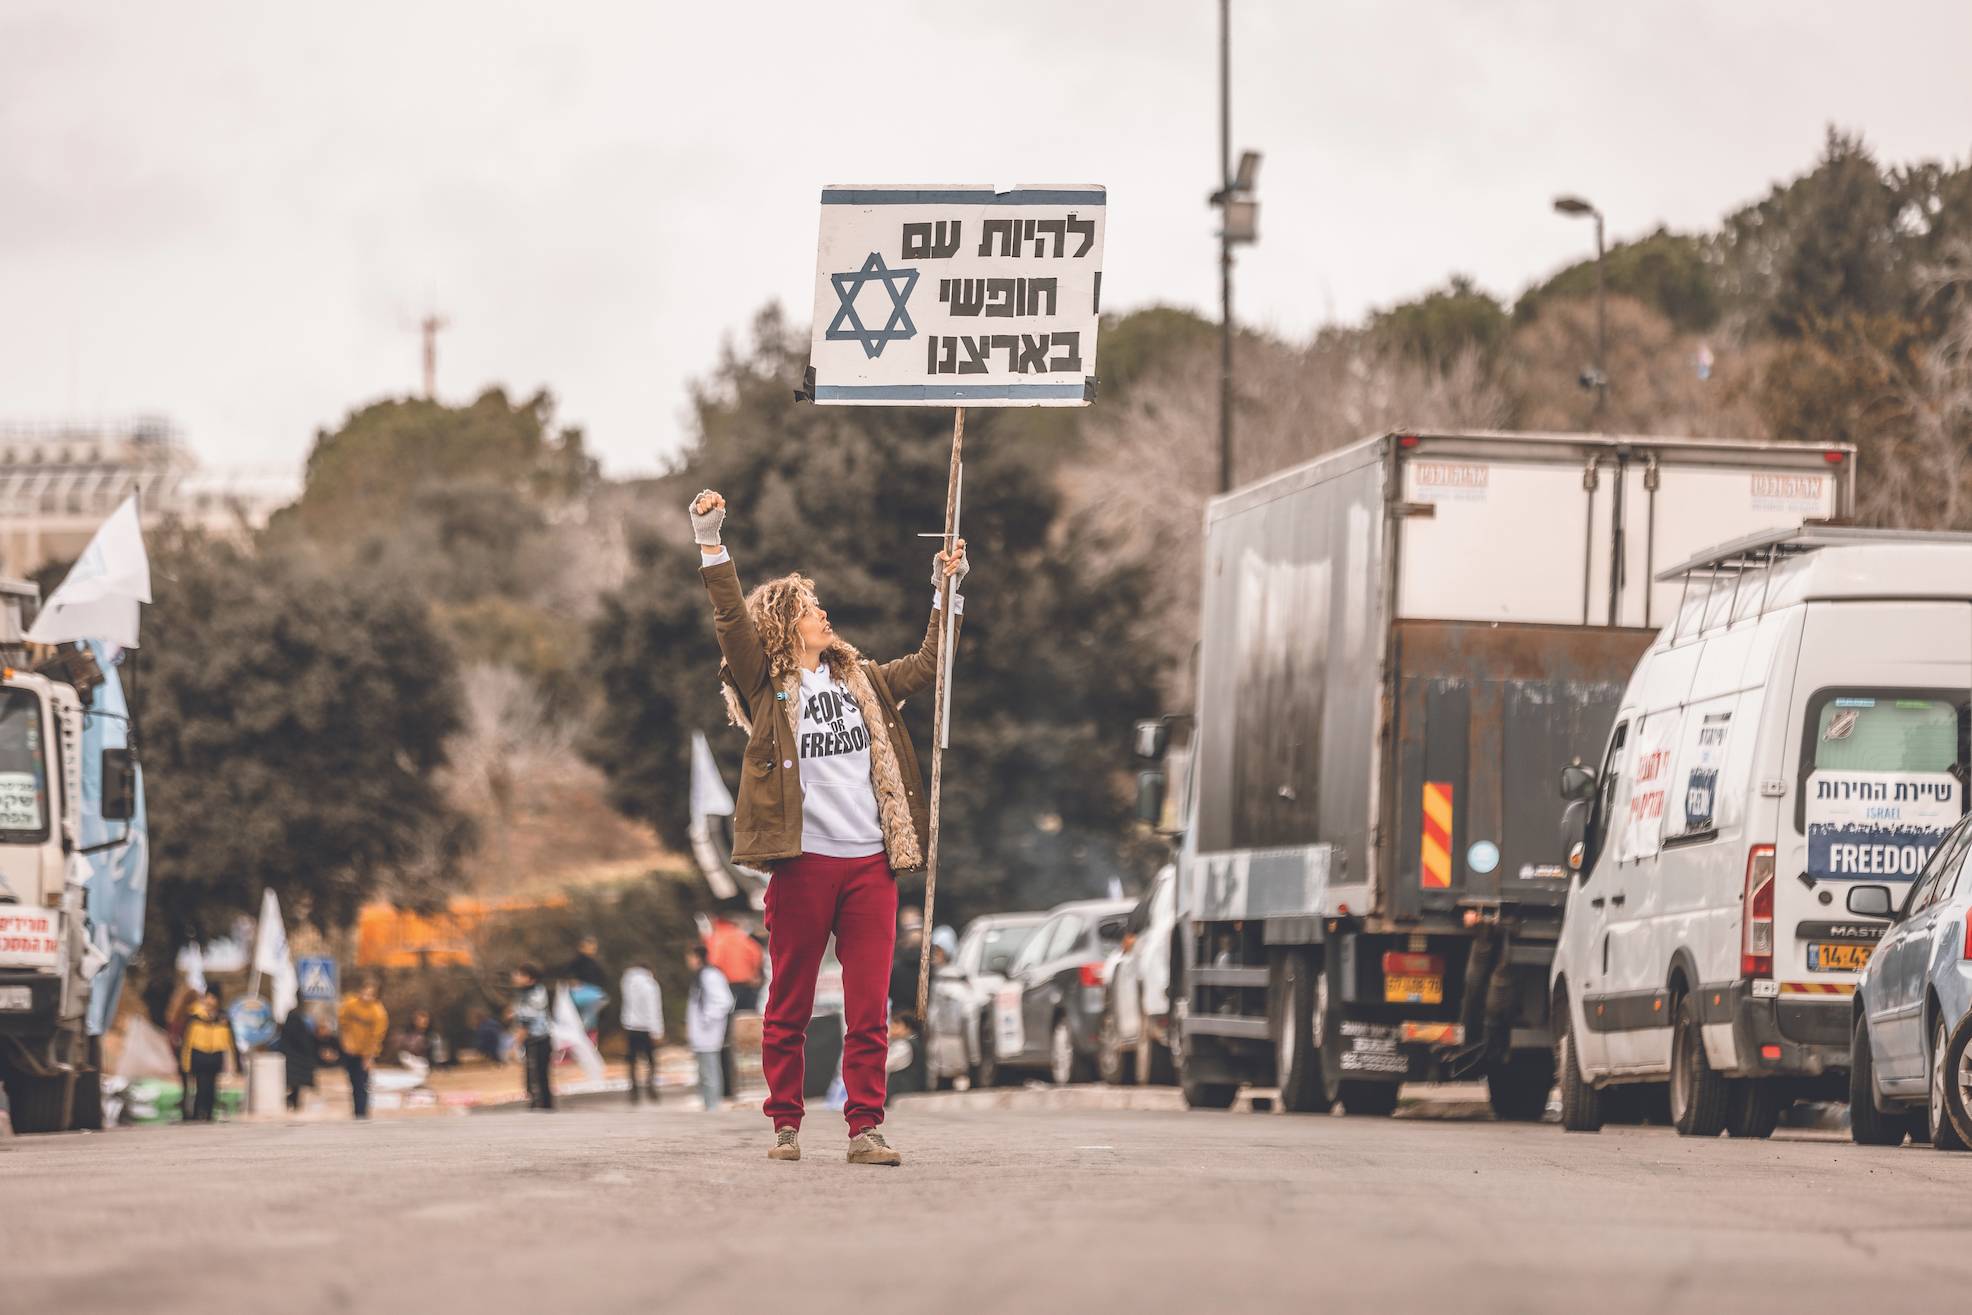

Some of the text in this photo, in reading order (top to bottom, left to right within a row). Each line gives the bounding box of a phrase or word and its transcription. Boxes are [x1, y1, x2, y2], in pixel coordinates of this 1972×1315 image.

[902, 214, 1095, 260] להיות עם
[939, 278, 1057, 318] חופשי
[928, 331, 1082, 375] בארצנו
[1816, 781, 1952, 802] שיירת החירות
[1866, 807, 1901, 820] ISRAEL
